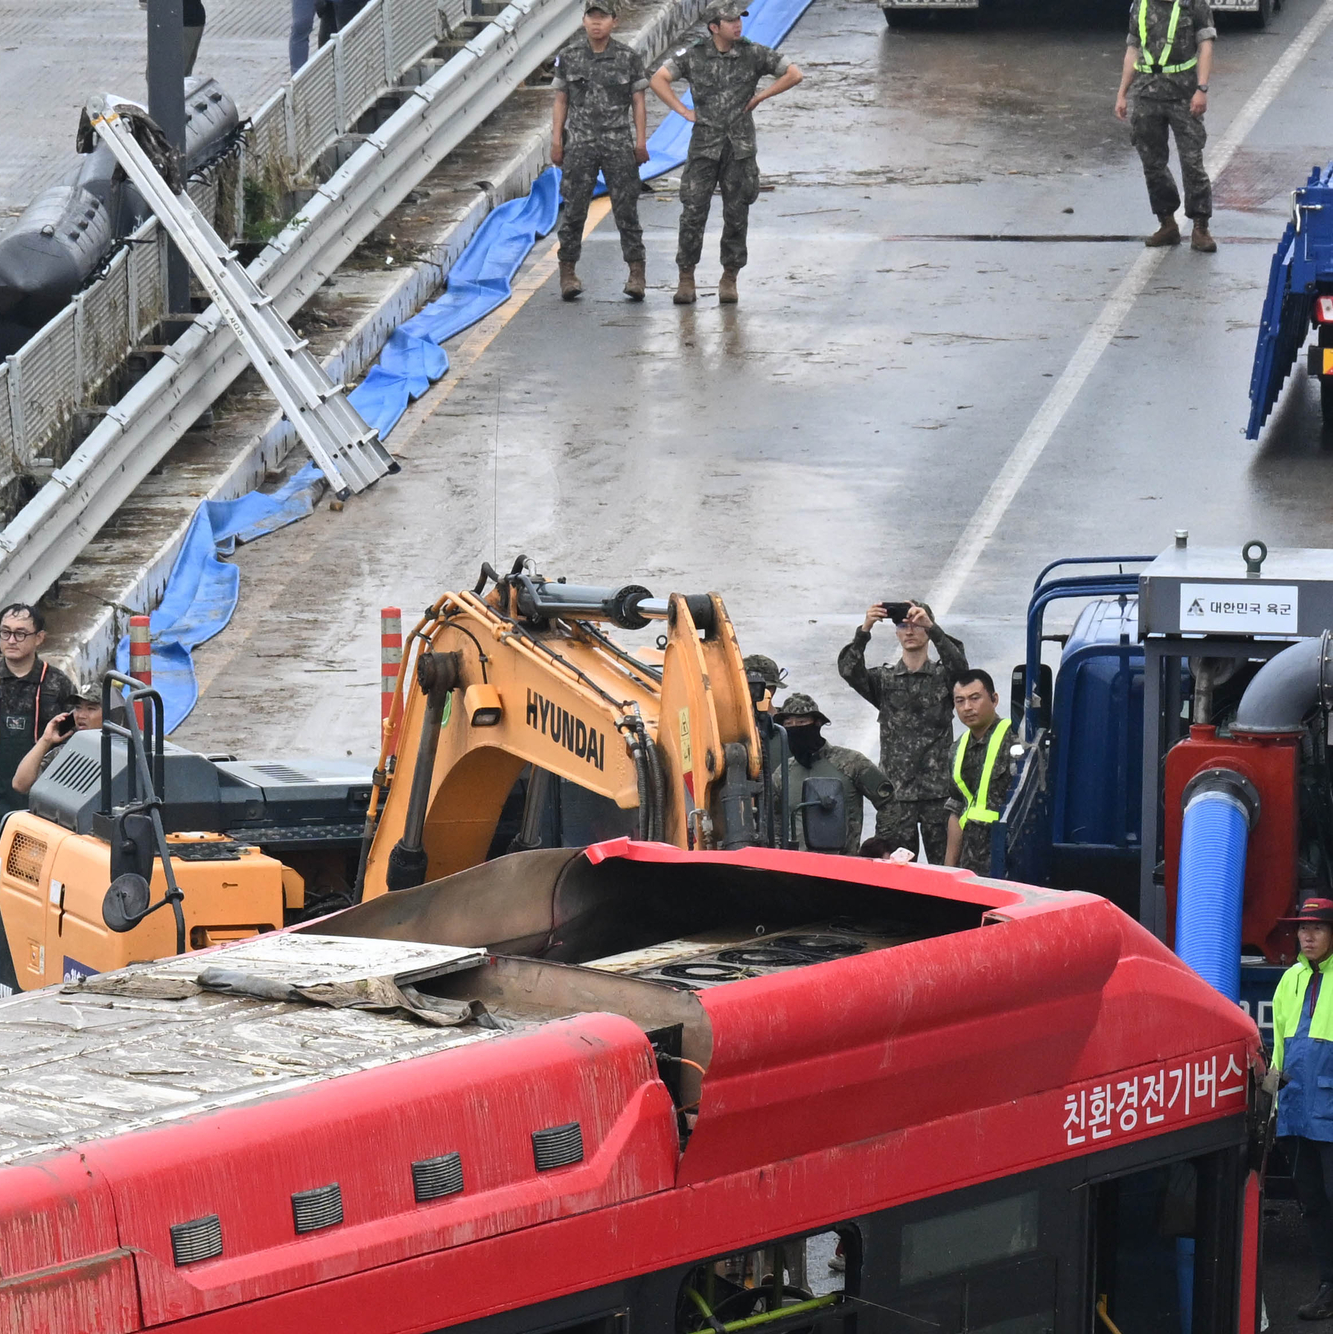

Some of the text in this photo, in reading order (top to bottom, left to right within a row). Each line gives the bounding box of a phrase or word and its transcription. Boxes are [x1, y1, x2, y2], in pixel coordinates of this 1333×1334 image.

[1210, 602, 1291, 616] 대한민국 육군
[526, 687, 605, 772] HYUNDAI
[1063, 1053, 1244, 1146] 친환경전기버스
